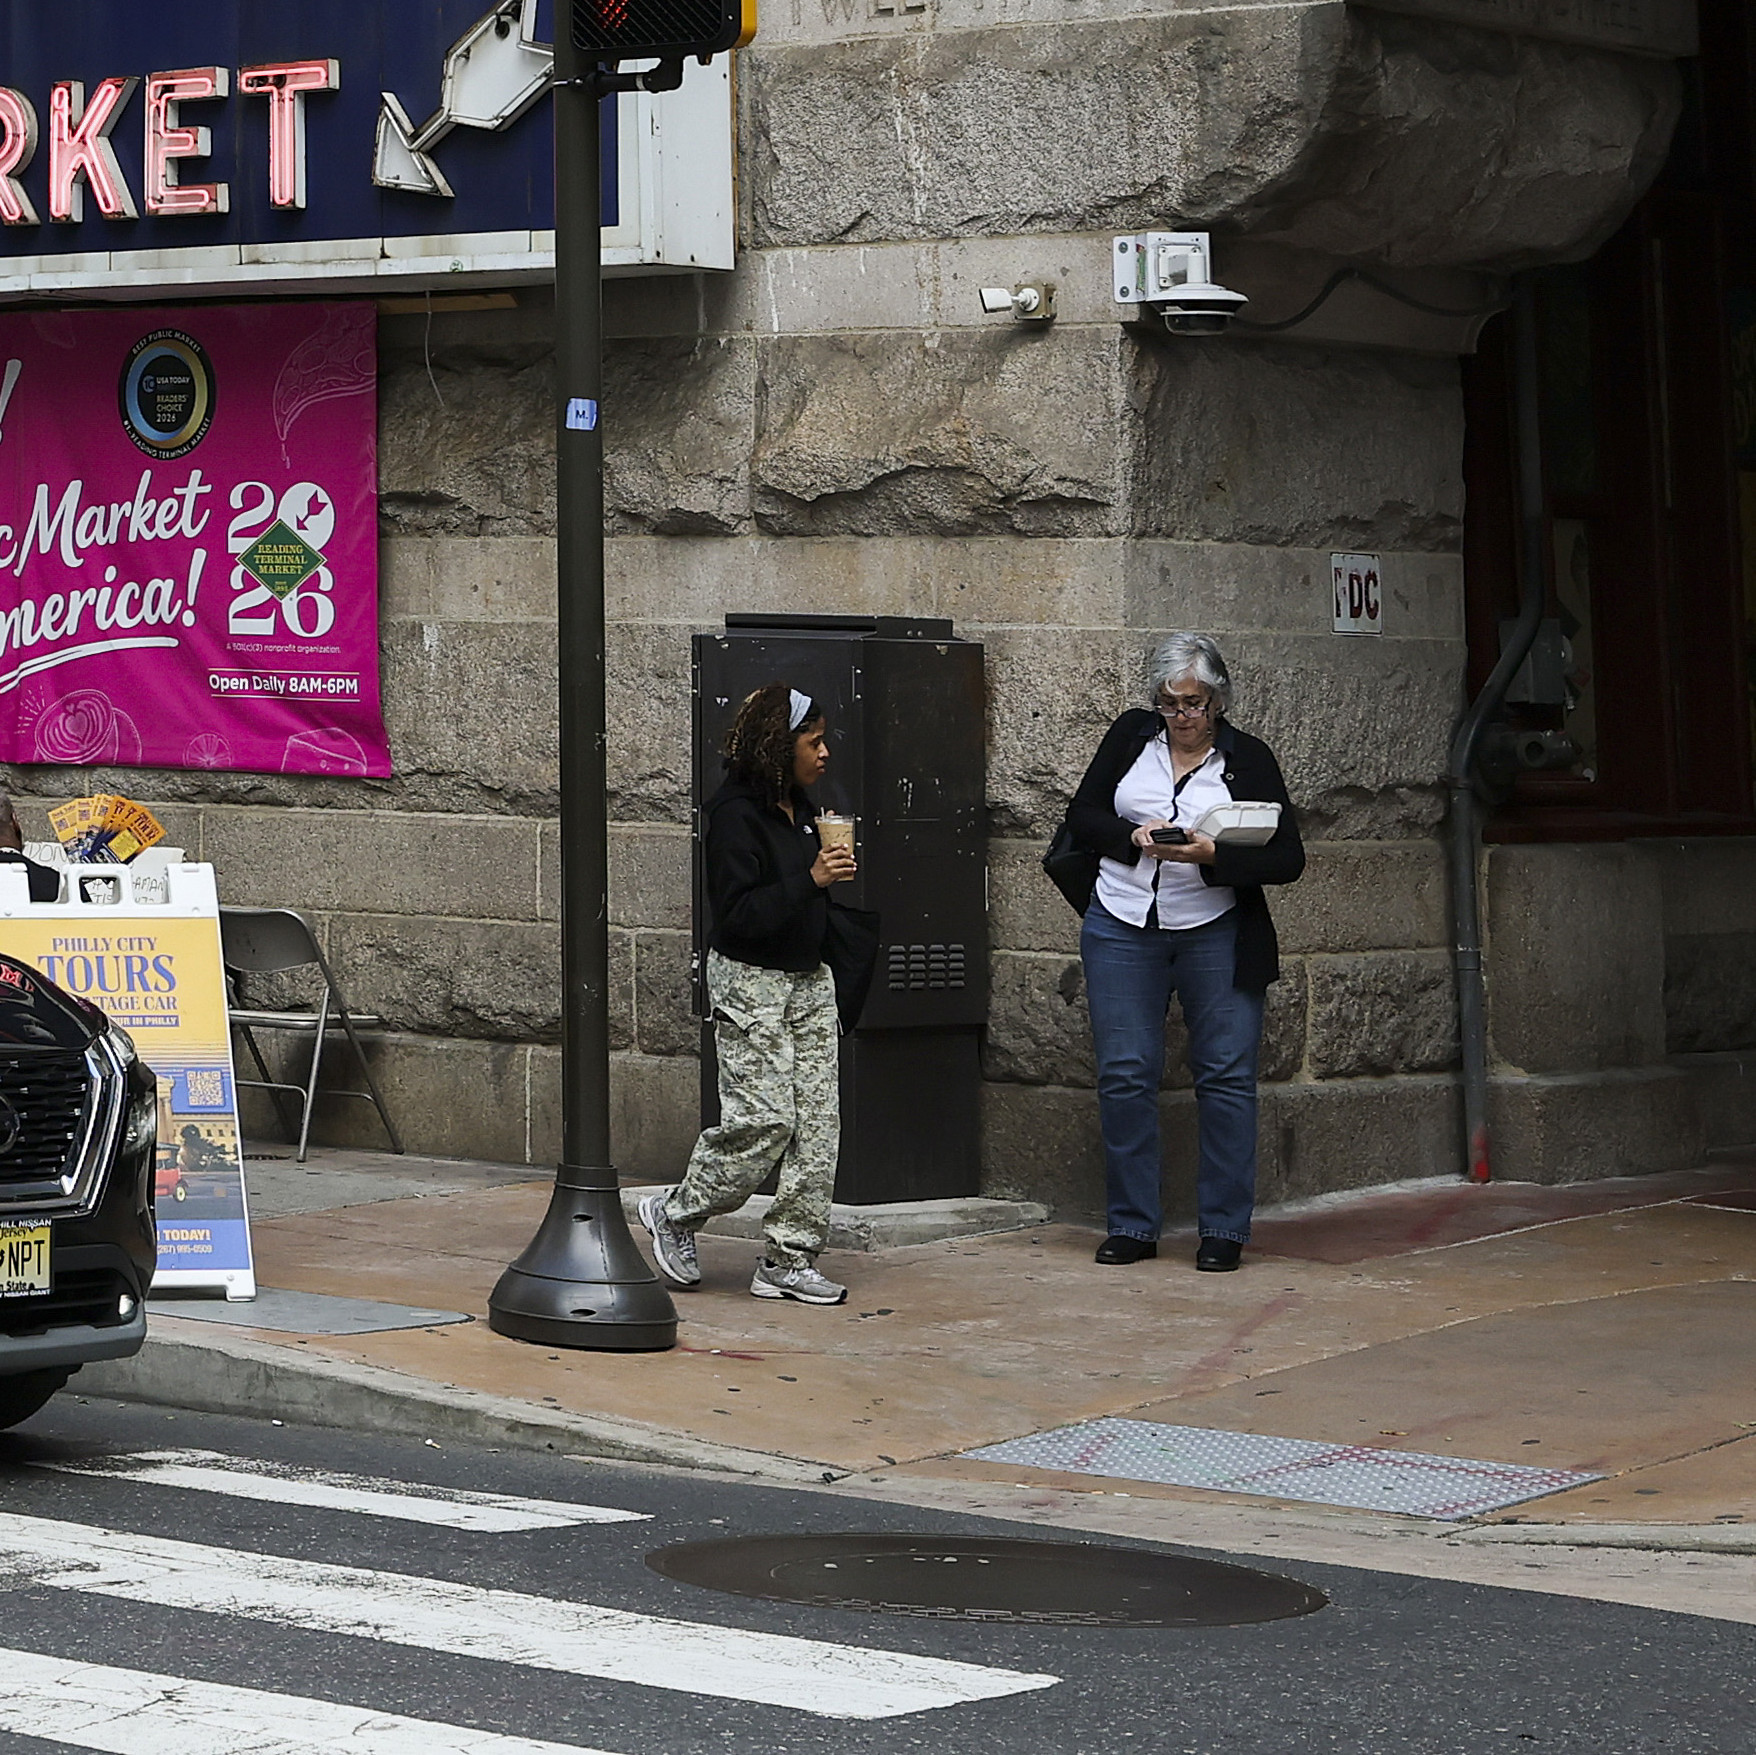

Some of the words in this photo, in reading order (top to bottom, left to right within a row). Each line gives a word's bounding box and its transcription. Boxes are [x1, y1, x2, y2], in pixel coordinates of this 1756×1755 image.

[156, 403, 183, 412] CHOICE
[15, 468, 213, 576] Market
[257, 544, 304, 554] READING
[253, 554, 308, 564] TERMINAL
[258, 565, 303, 575] MARKET
[264, 644, 296, 653] nonprofit
[209, 674, 249, 691] Open
[252, 675, 286, 694] Daily
[289, 676, 358, 694] 8AM-6PM
[52, 937, 112, 952] PHILLY
[111, 937, 157, 952] CITY
[37, 954, 177, 993] TOURS
[144, 996, 178, 1011] CAR
[132, 1017, 143, 1025] IN
[144, 1016, 177, 1026] PHILLY
[18, 1219, 52, 1230] NISSAN
[0, 1228, 28, 1241] Jersey
[163, 1229, 212, 1241] TODAY!
[8, 1240, 45, 1278] NPT
[6, 1281, 27, 1292] State
[3, 1290, 29, 1298] NISSAN
